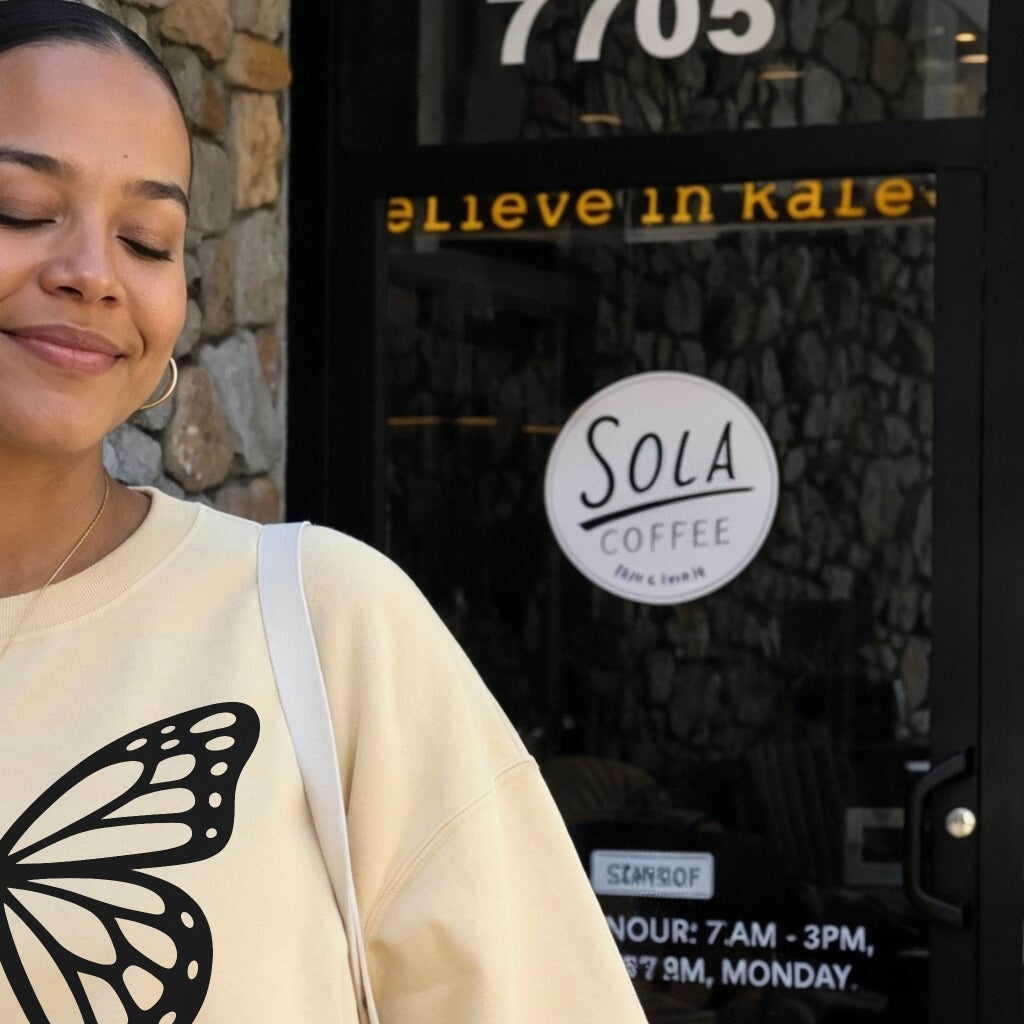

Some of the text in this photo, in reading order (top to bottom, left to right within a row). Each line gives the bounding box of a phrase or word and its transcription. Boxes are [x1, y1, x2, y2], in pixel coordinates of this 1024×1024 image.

[486, 0, 776, 65] 7705
[741, 176, 937, 221] kale
[580, 414, 736, 509] SOLA
[600, 517, 731, 557] COFFEE
